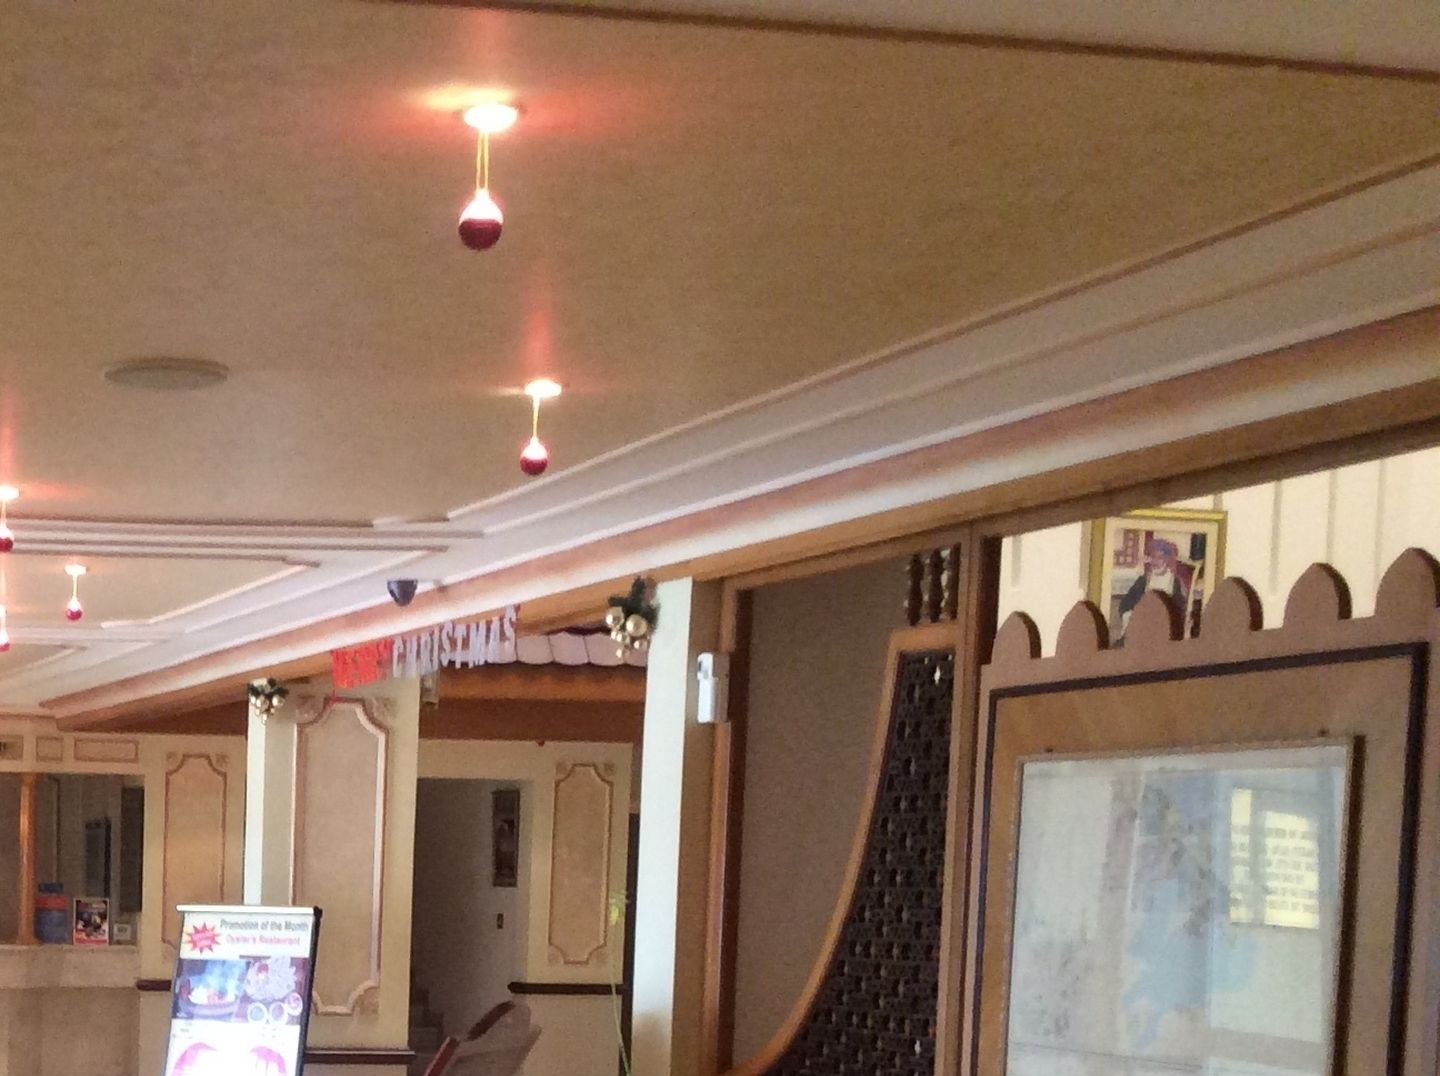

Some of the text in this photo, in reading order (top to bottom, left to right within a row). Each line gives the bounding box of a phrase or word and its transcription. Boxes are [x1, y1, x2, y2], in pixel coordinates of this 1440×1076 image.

[393, 604, 518, 679] CHRISTMAS
[220, 918, 309, 931] Promotion of the Month
